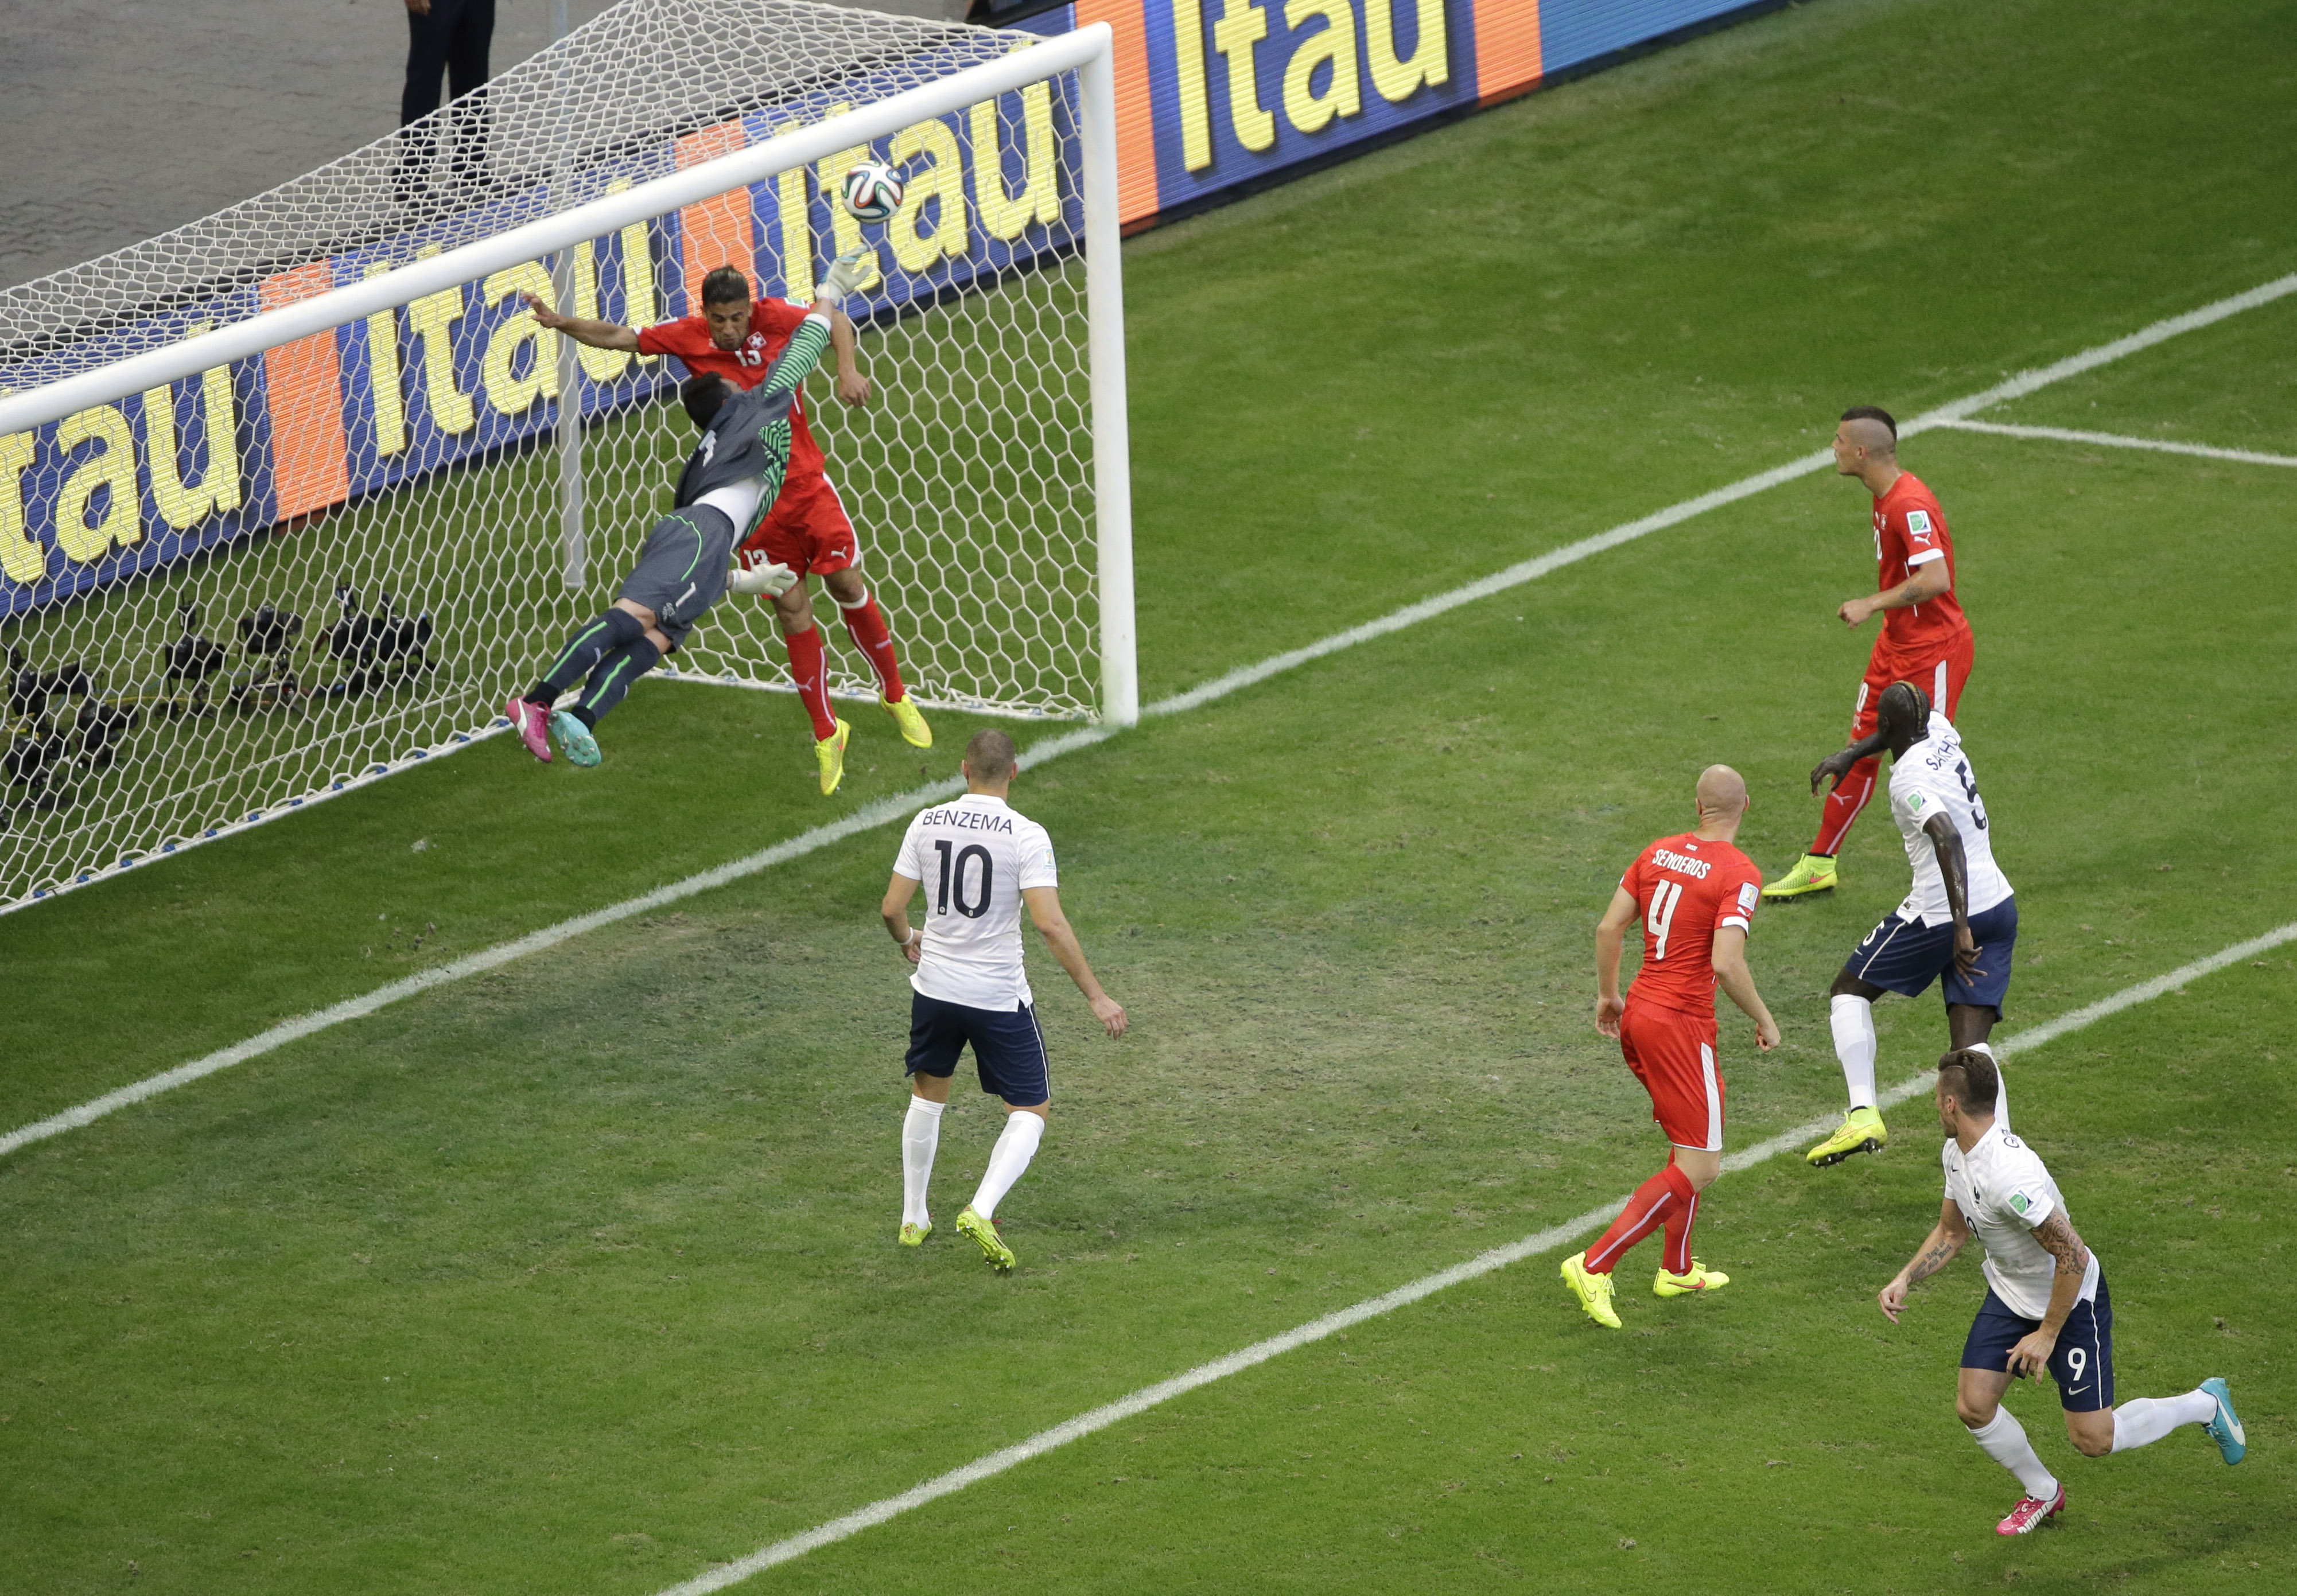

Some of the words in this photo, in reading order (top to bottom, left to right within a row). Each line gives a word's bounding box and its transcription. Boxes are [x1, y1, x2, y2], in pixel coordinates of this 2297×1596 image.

[1926, 735, 1958, 770] SAKHO
[1954, 759, 1987, 830] 5
[923, 809, 1012, 835] BENZEMA
[935, 839, 993, 919] 10
[1651, 848, 1712, 879] SENDEROS
[1647, 878, 1683, 960] 4
[2067, 1347, 2086, 1381] 9
